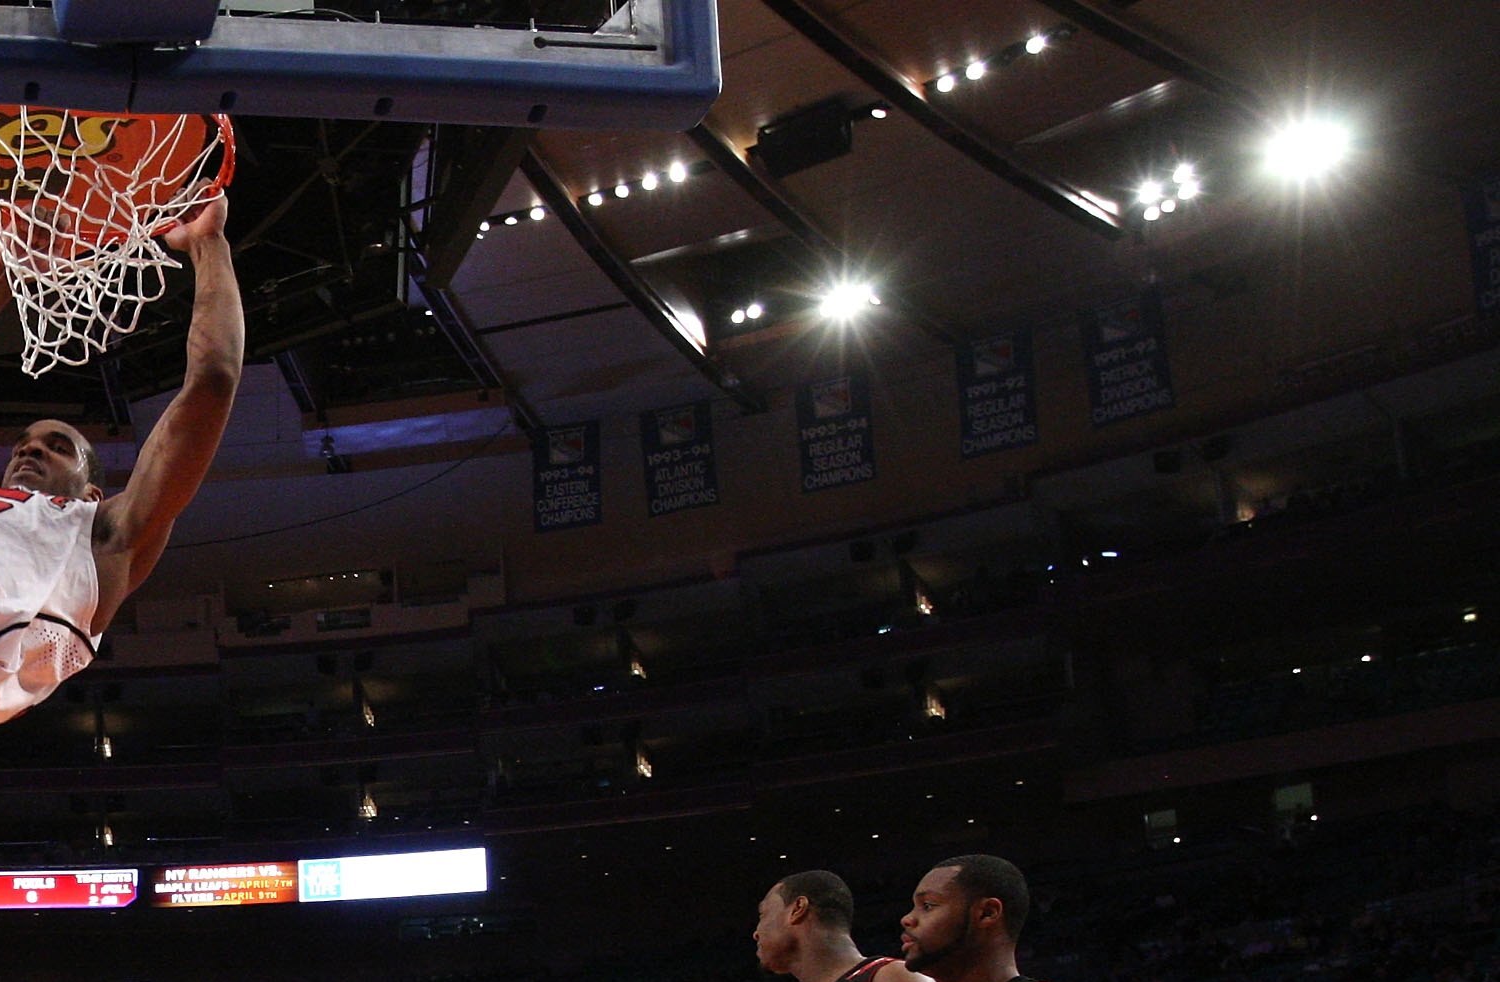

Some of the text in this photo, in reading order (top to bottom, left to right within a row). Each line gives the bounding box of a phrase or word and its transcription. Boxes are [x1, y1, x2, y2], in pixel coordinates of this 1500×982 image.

[812, 449, 862, 472] SEASON
[654, 461, 707, 484] ATLANTIC
[803, 463, 875, 489] CHAMPIONS
[545, 480, 589, 499] EASTERN
[658, 478, 705, 498] DIVISION
[537, 492, 599, 513] CONFERENCE
[651, 488, 717, 514] CHAMPIONS
[540, 506, 597, 526] CHAMPIONS
[165, 869, 186, 881] NY
[188, 867, 256, 879] RANGERS
[238, 880, 269, 889] APRIL
[273, 879, 293, 888] 7TH
[223, 892, 254, 901] APRIL
